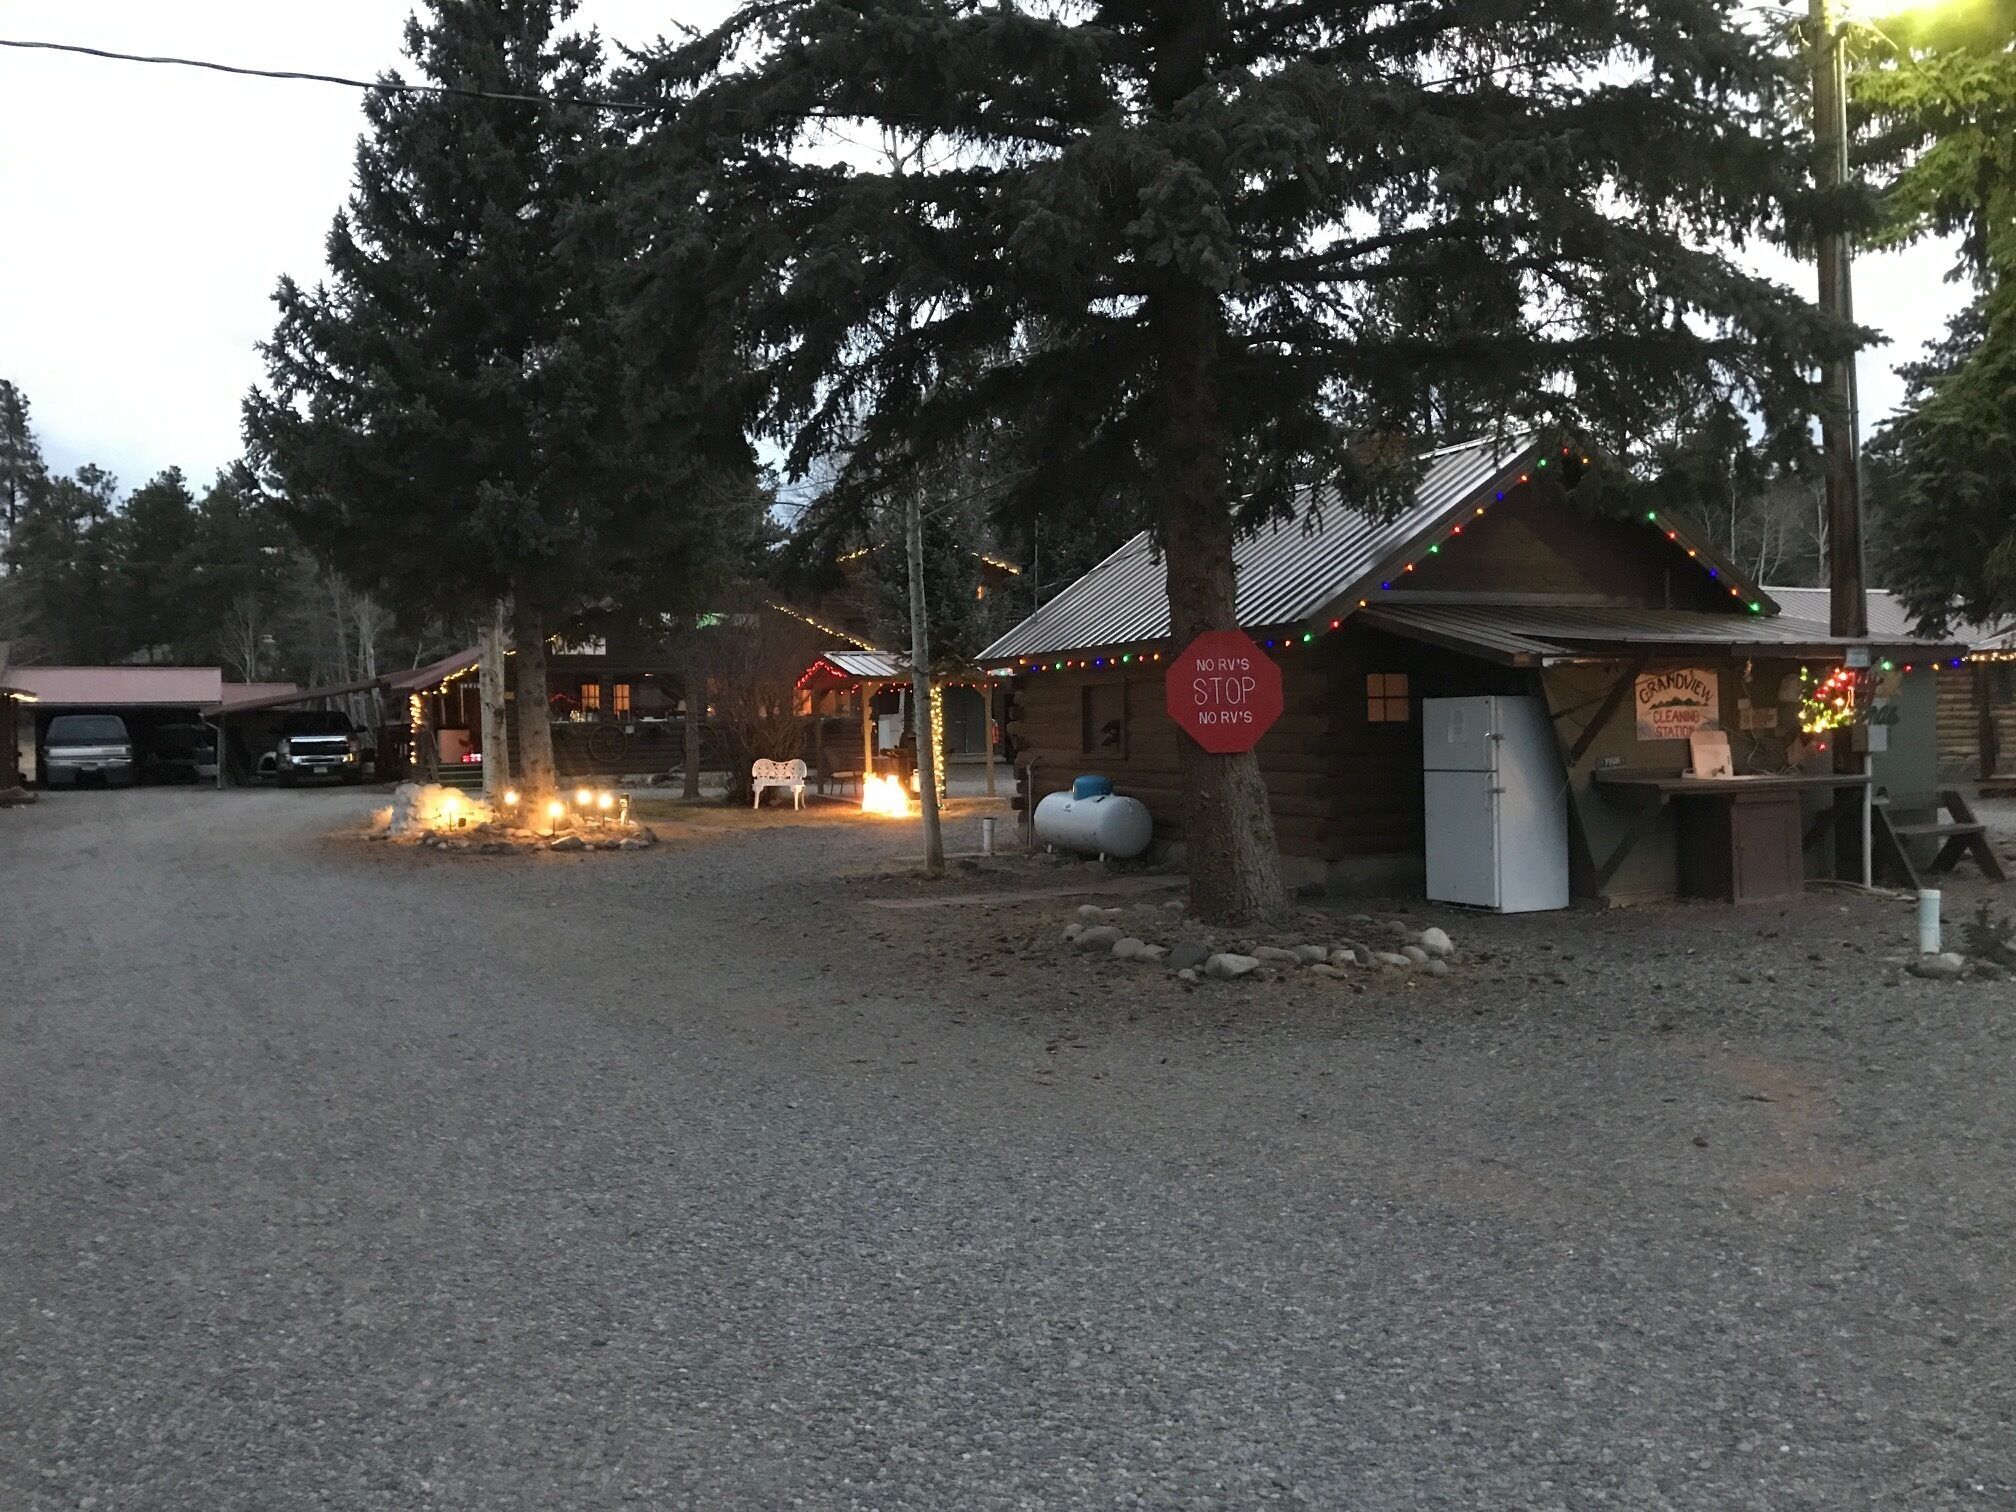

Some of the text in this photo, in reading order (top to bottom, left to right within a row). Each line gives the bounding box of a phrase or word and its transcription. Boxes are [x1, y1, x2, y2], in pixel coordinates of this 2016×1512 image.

[1196, 658, 1250, 672] NO RV'S
[1193, 676, 1256, 705] STOP
[1639, 672, 1714, 704] GRANDVIEW
[1198, 710, 1253, 724] NO RV'S
[1653, 709, 1700, 724] CLEANING
[1656, 725, 1695, 738] STATION
